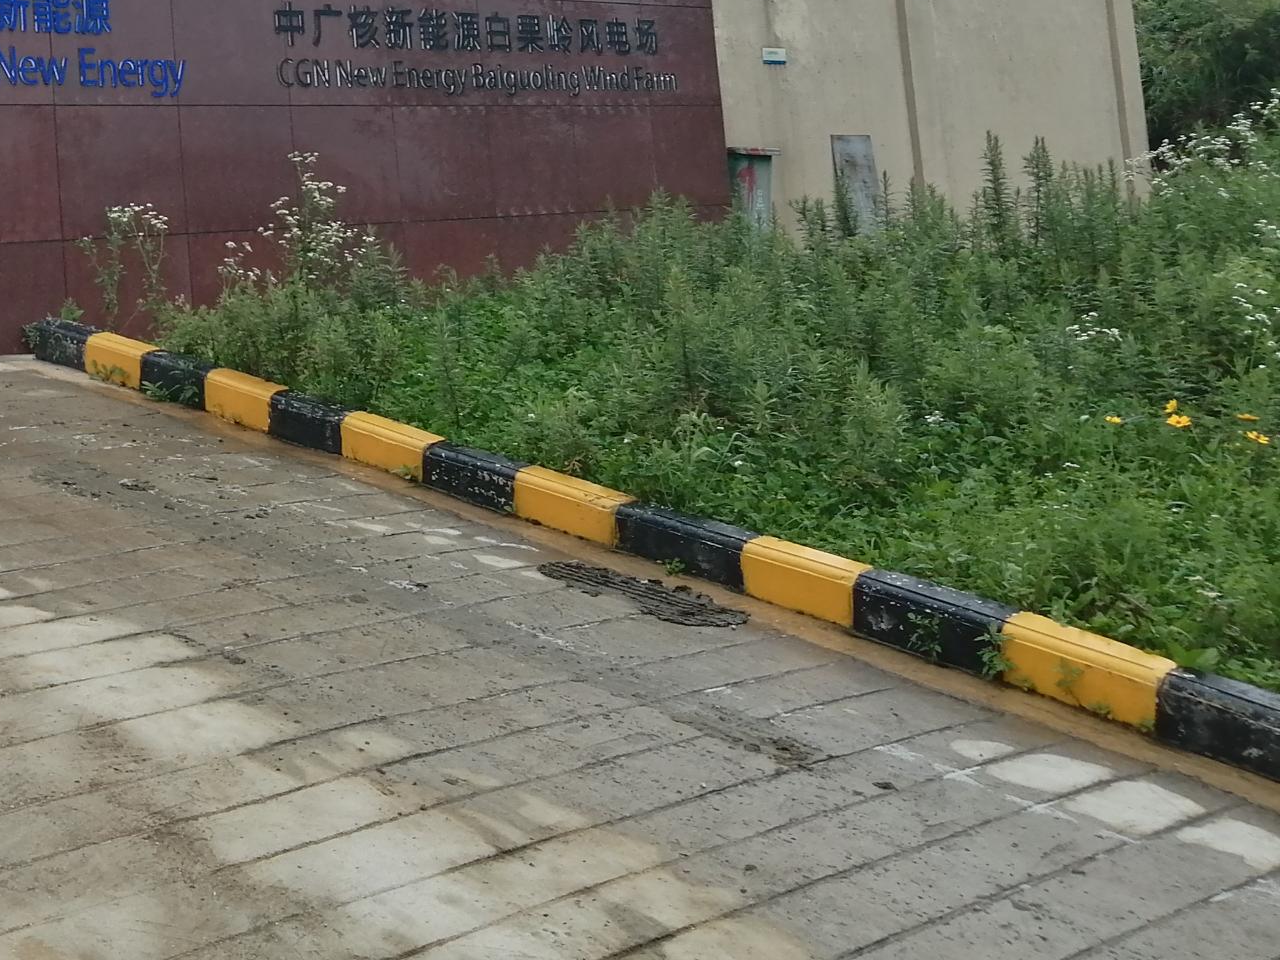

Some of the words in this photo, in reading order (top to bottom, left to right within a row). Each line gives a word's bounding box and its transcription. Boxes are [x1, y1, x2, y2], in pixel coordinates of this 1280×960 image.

[273, 1, 659, 56] 中广核新能源白果岭风电场
[77, 47, 187, 98] Energy
[276, 57, 330, 88] CGN
[334, 59, 387, 89] New
[391, 60, 467, 96] Energy
[470, 62, 581, 98] Baiguoling
[581, 65, 630, 92] Wind
